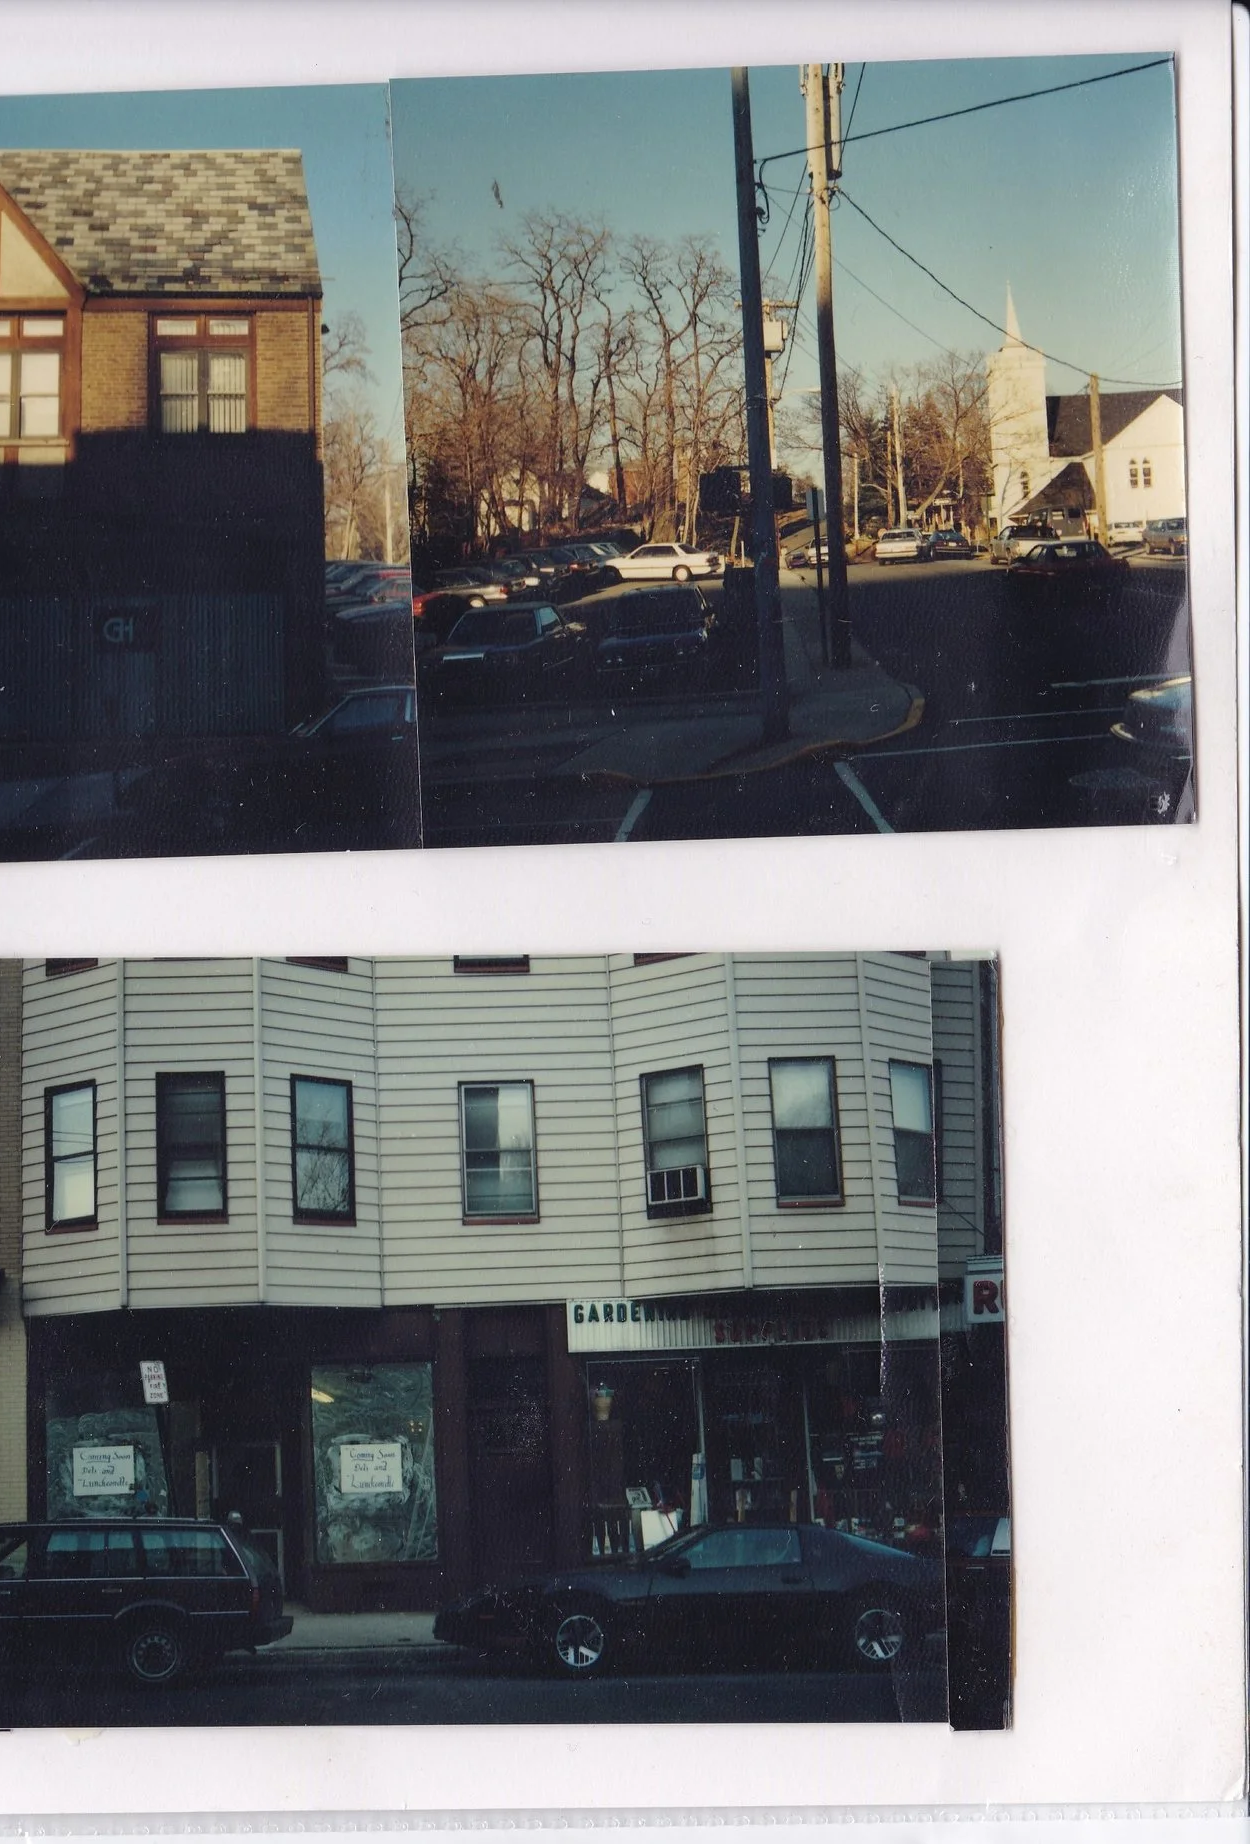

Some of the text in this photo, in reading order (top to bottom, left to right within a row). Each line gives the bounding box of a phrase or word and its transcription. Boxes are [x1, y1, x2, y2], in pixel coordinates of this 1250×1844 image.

[973, 1279, 1004, 1315] R
[79, 1451, 131, 1463] Coming Soon
[101, 1464, 115, 1475] and
[374, 1460, 388, 1471] and
